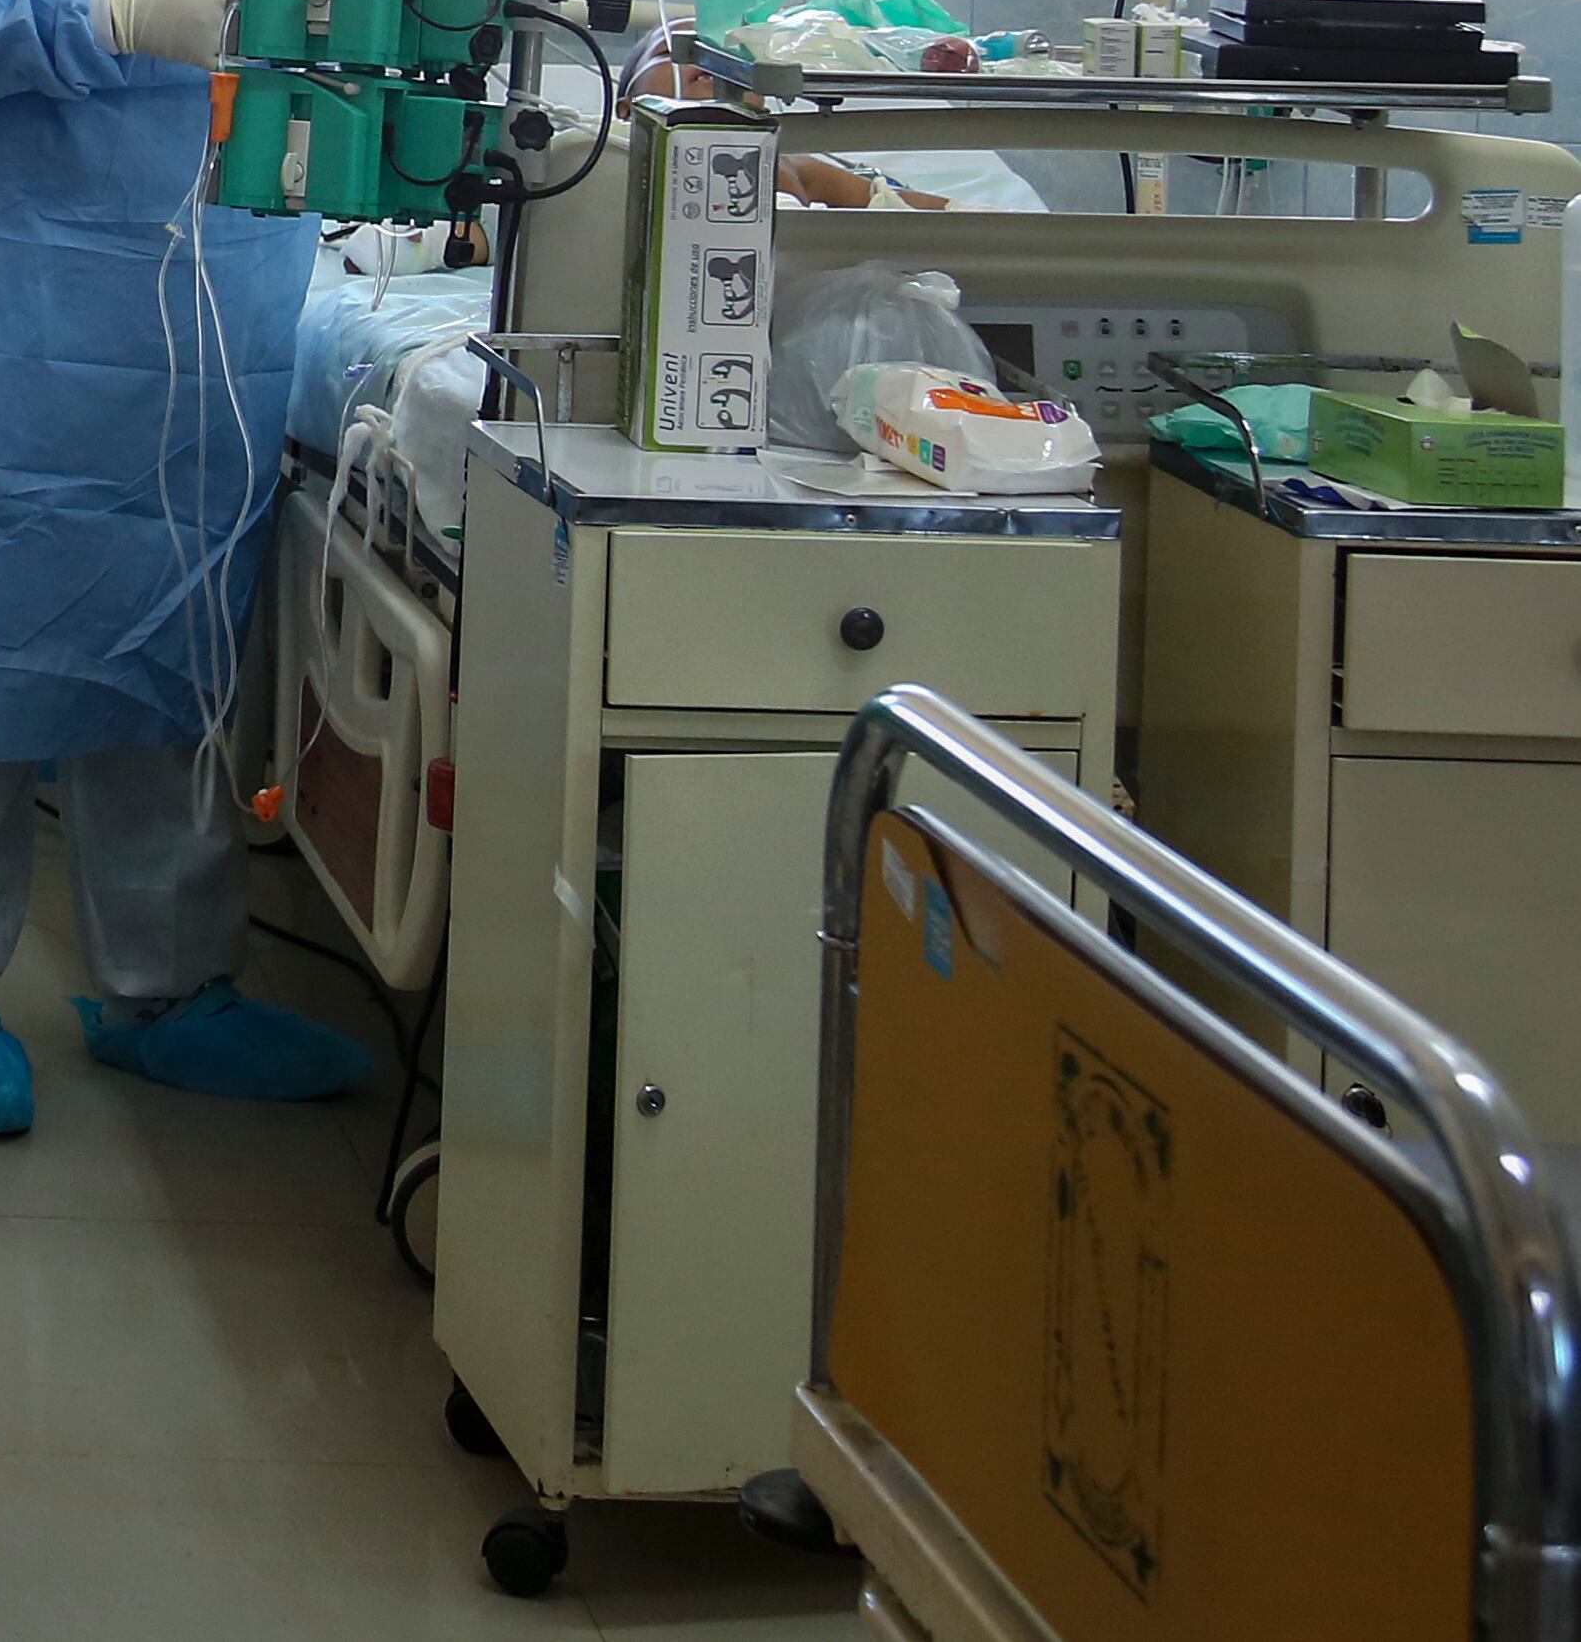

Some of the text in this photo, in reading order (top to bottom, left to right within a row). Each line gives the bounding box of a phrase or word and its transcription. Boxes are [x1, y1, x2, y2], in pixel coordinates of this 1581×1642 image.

[689, 261, 699, 275] de
[687, 276, 699, 334] Instrucciones
[659, 352, 679, 432] Univent
